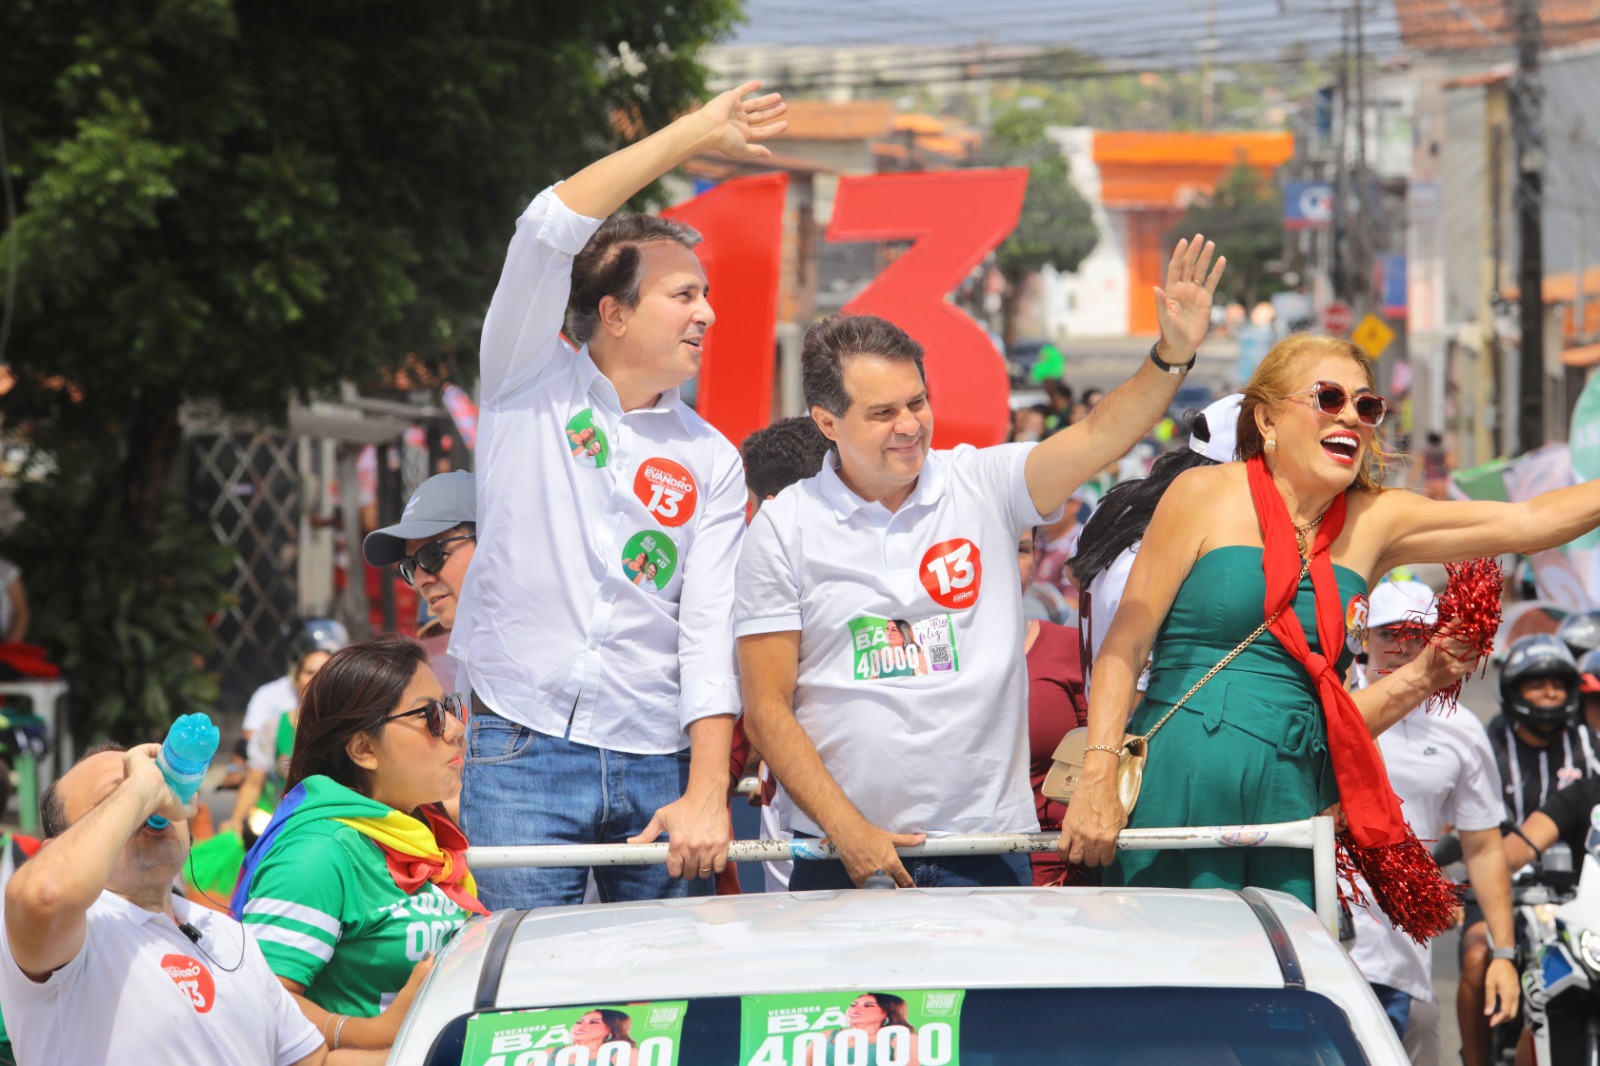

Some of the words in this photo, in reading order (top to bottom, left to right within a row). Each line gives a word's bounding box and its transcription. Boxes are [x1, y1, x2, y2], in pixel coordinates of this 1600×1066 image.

[660, 168, 1029, 448] 13
[644, 468, 693, 492] EVANDRO
[647, 484, 685, 518] 13
[926, 542, 975, 596] 13
[856, 643, 920, 678] 40000
[768, 1006, 821, 1017] VEREADORA
[494, 1024, 546, 1037] VEREADORA
[747, 1022, 952, 1066] 40000
